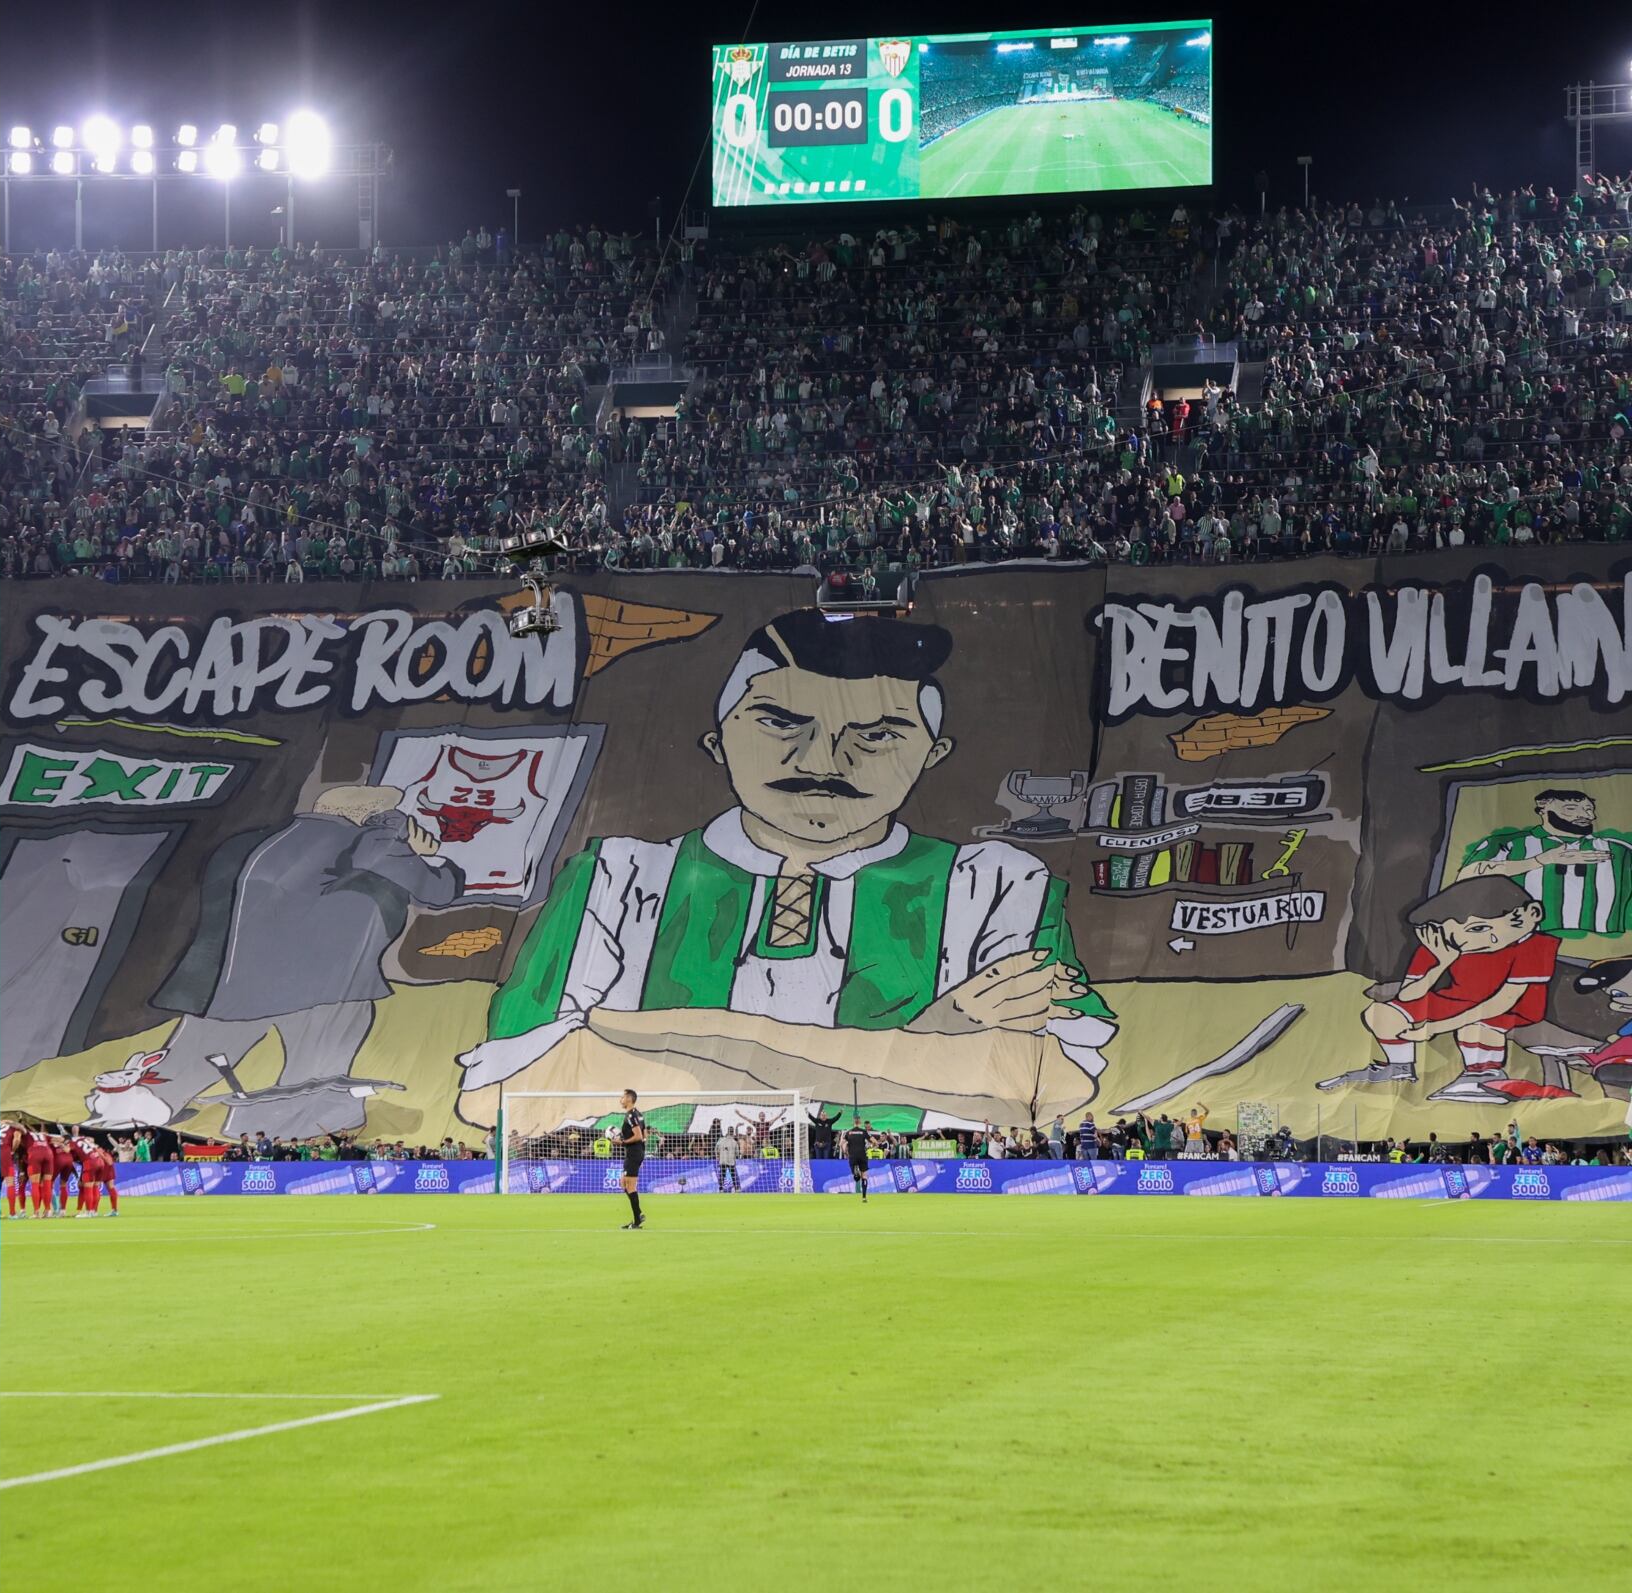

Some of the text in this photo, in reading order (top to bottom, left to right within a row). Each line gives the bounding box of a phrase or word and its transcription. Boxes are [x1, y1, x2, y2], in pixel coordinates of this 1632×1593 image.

[780, 44, 857, 59] DÍA DE BETIS
[786, 63, 852, 77] JORNADA 13
[774, 101, 862, 132] 00:00
[878, 88, 913, 143] 0
[723, 94, 757, 148] 0
[9, 590, 576, 718] ESCAPE ROOM
[1095, 589, 1345, 716] BENITO
[11, 752, 229, 803] EXIT
[450, 786, 496, 806] 23
[1180, 896, 1315, 929] VESTUARIO
[1177, 1152, 1219, 1160] #FANCAM
[1338, 1154, 1380, 1162] #FANCAM
[246, 1171, 273, 1180] ZERO
[420, 1170, 447, 1179] ZERO
[960, 1169, 989, 1178] ZERO
[1141, 1171, 1170, 1180] ZERO
[1326, 1172, 1356, 1182] ZERO
[243, 1180, 275, 1190] SODIO
[416, 1180, 448, 1188] SODIO
[957, 1178, 991, 1188] SODIO
[1139, 1180, 1173, 1190] SODIO
[1516, 1175, 1547, 1185] ZERO
[1323, 1182, 1359, 1192] SODIO
[1513, 1185, 1549, 1194] SODIO
